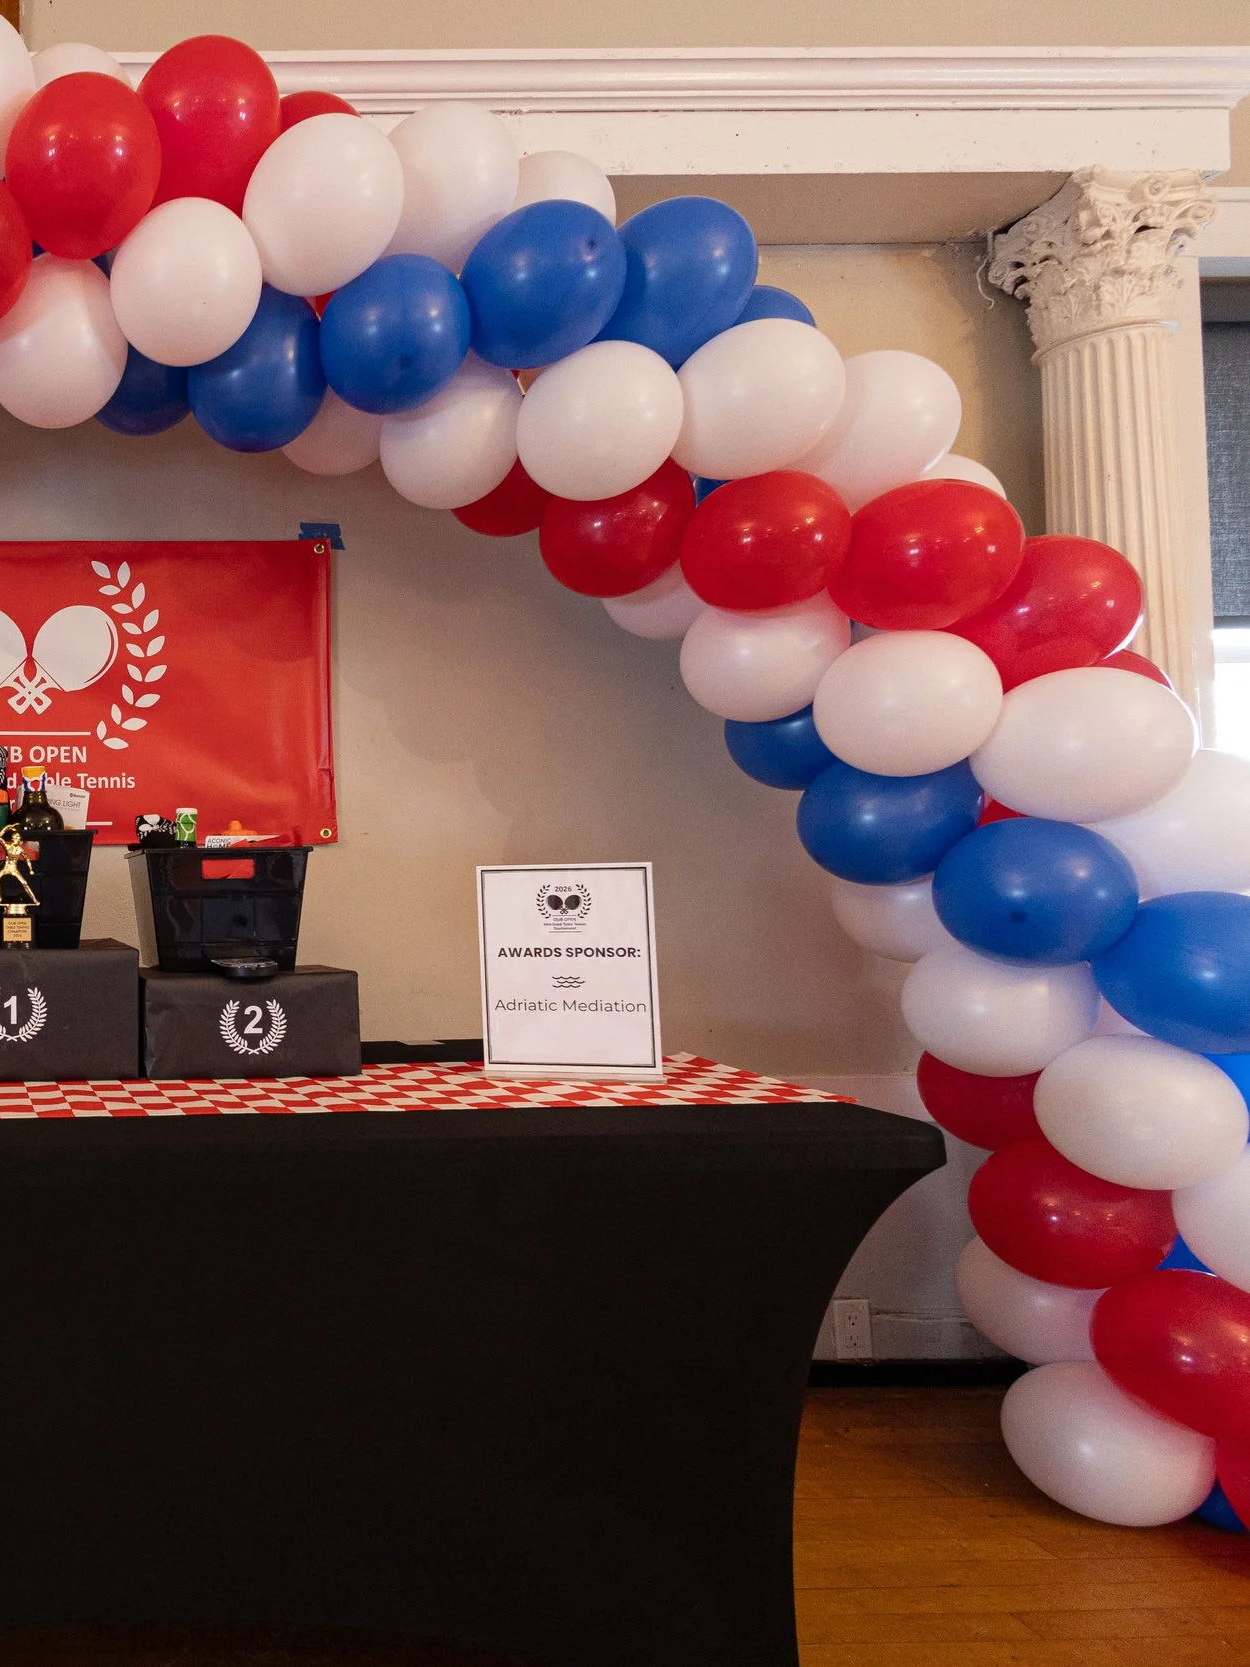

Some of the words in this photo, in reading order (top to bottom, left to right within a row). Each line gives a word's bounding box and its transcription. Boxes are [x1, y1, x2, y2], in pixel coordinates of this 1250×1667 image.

[29, 745, 87, 764] OPEN
[76, 772, 136, 789] Tennis
[62, 799, 81, 809] LIGHT
[554, 885, 572, 893] 2026
[497, 947, 563, 958] AWARDS
[565, 947, 641, 958] SPONSOR:
[3, 995, 17, 1025] 1
[494, 999, 558, 1012] Adriatic
[563, 999, 647, 1013] Mediation
[243, 1005, 263, 1034] 2
